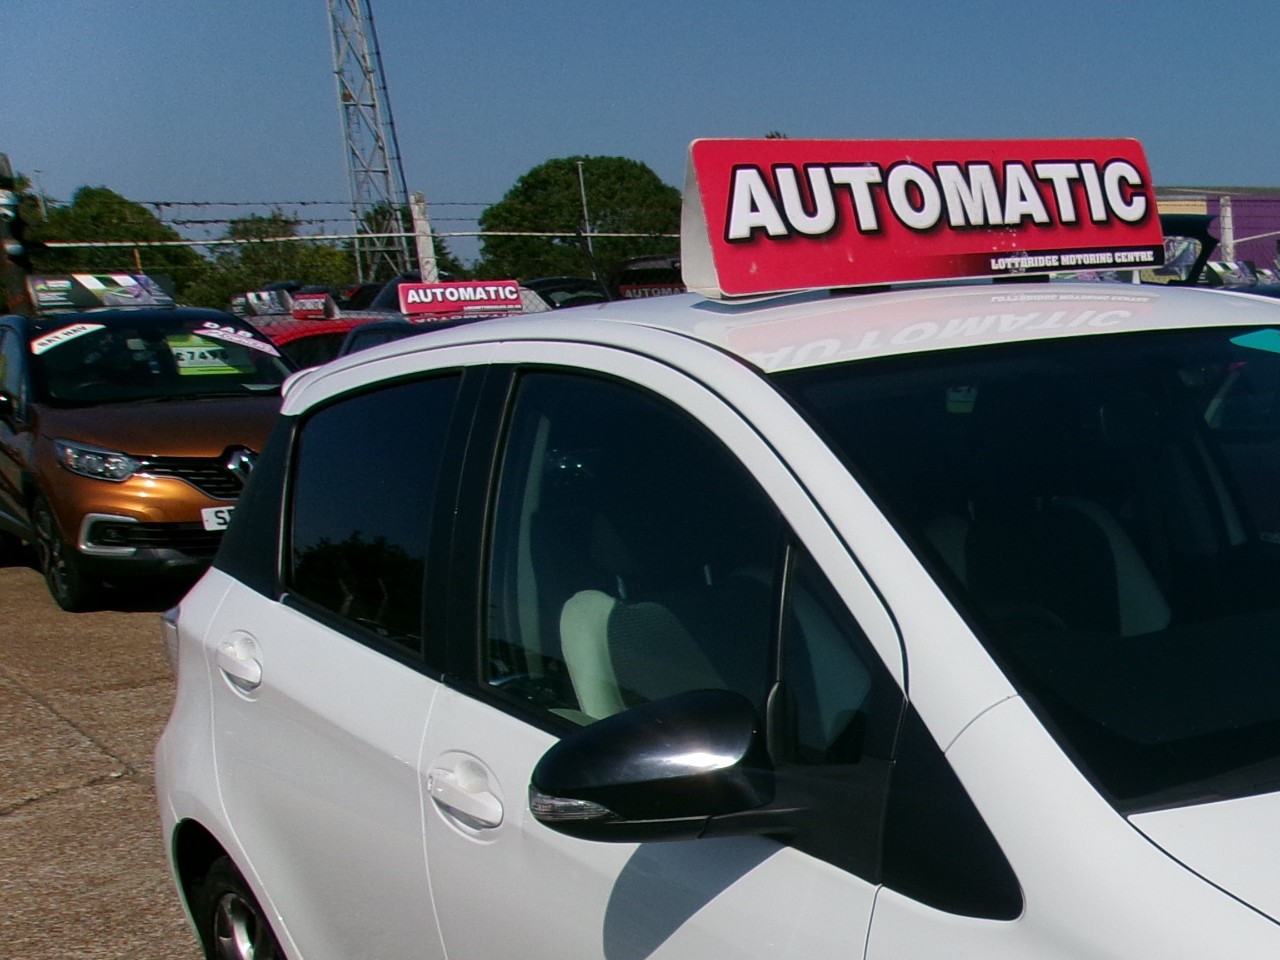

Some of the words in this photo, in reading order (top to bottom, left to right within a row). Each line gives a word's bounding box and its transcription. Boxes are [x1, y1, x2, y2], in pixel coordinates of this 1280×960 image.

[727, 159, 1148, 241] AUTOMATIC
[990, 255, 1059, 270] LOTTBRIDGE
[1061, 252, 1113, 266] MOTORING
[1114, 250, 1154, 263] CENTRE
[407, 285, 518, 303] AUTOMATIC
[202, 321, 254, 338] DAB
